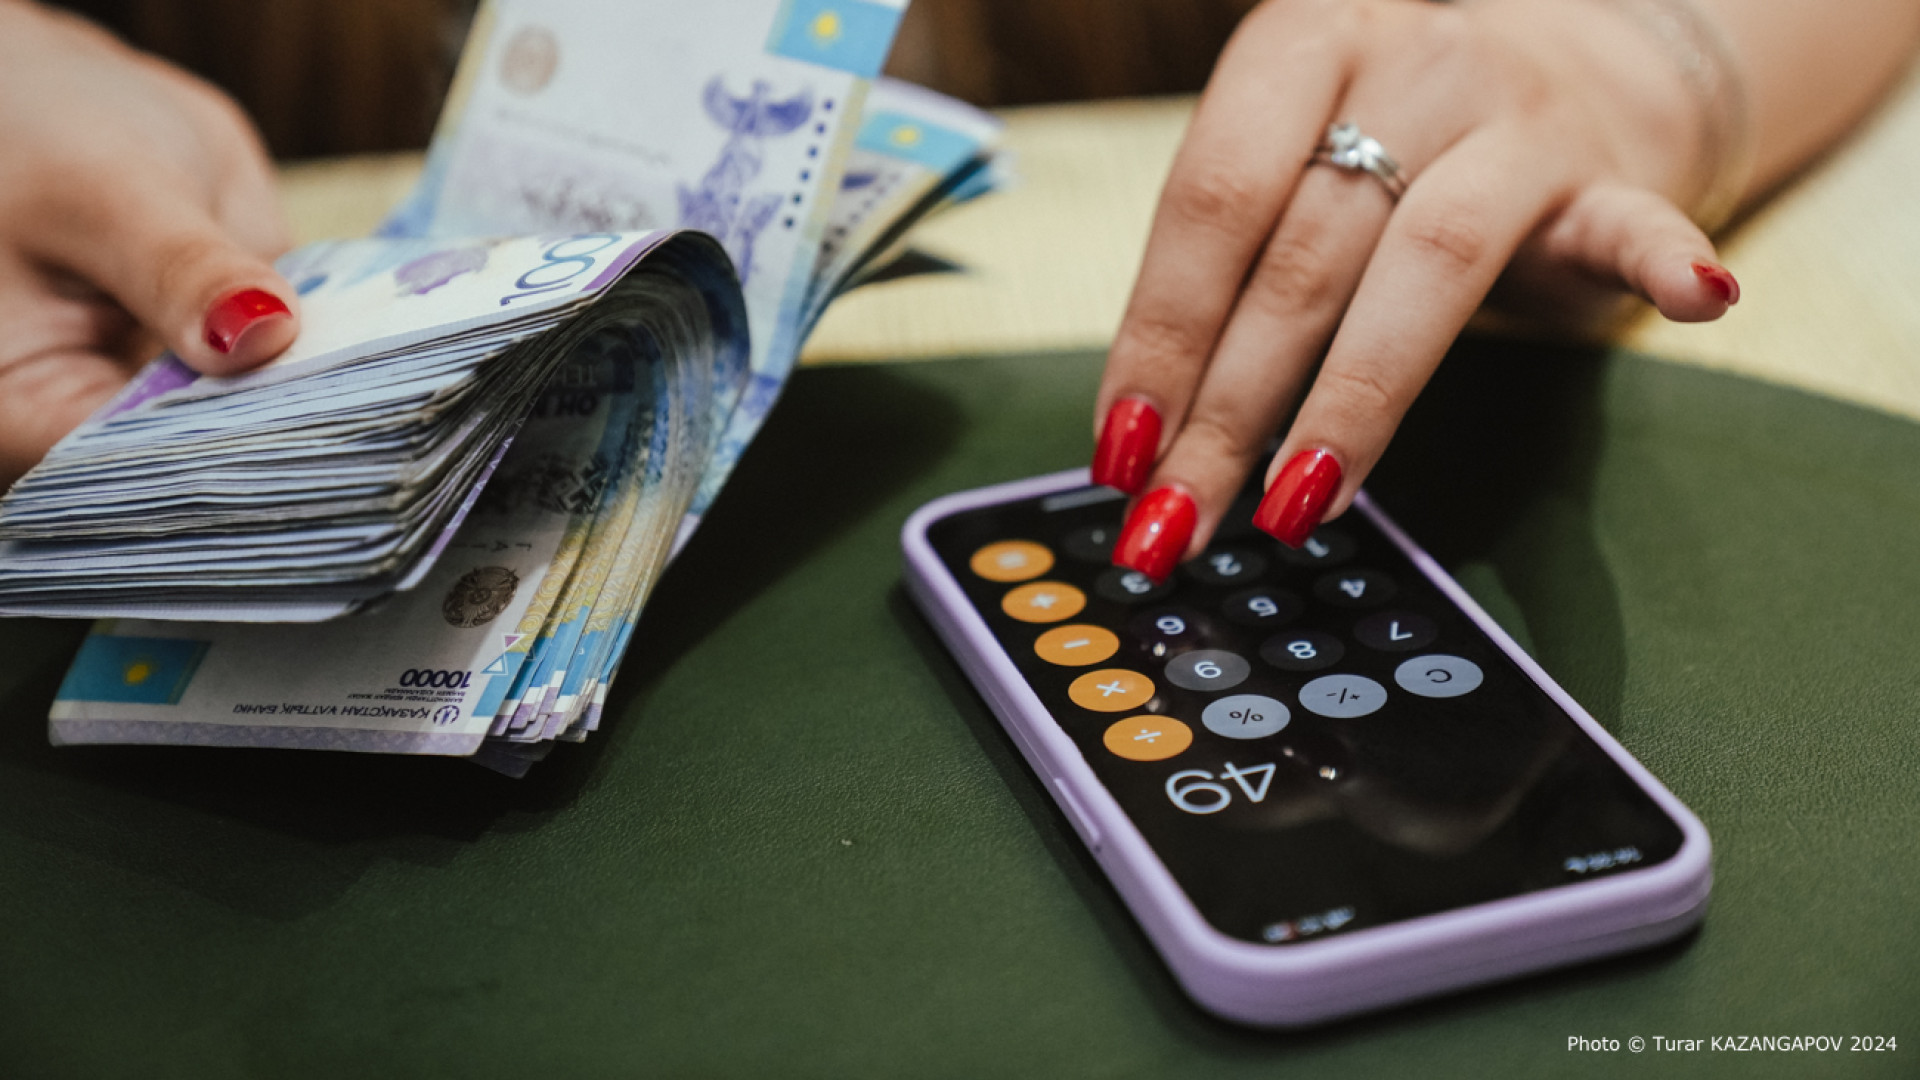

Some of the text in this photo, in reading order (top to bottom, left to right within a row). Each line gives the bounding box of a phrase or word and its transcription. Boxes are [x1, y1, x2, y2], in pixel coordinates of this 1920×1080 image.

[1209, 553, 1242, 577] 2
[1338, 578, 1367, 598] 4
[1247, 595, 1279, 617] 5
[1156, 615, 1186, 635] 6
[1389, 621, 1413, 641] 7
[1287, 640, 1317, 660] 8
[400, 669, 471, 689] 10000
[1194, 660, 1222, 679] 9
[1425, 668, 1452, 683] C
[341, 705, 430, 719] ҚАЗАҚСТАН
[1165, 761, 1277, 815] 49
